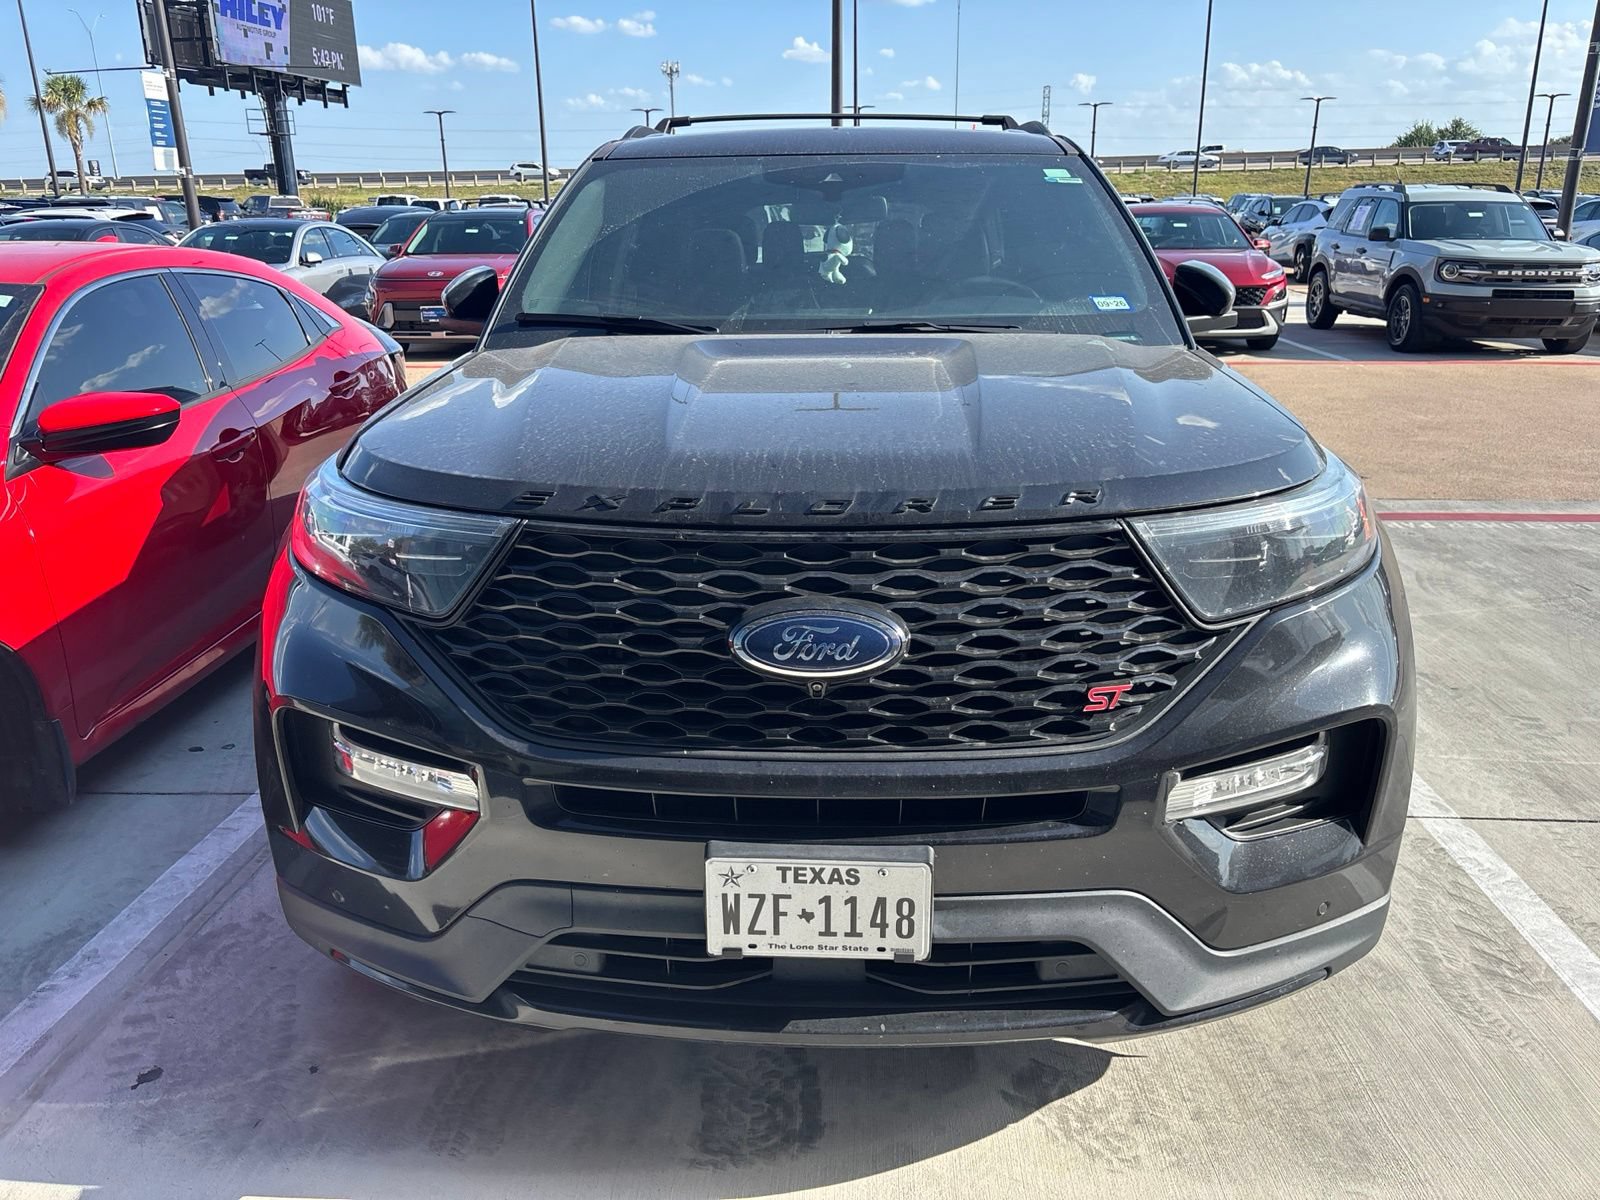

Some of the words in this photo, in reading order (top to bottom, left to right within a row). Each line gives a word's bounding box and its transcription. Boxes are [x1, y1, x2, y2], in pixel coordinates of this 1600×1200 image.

[503, 489, 1103, 516] EXPLORER
[773, 624, 861, 661] Ford
[1083, 684, 1134, 711] ST
[776, 866, 860, 885] TEXAS
[790, 943, 815, 951] Lone
